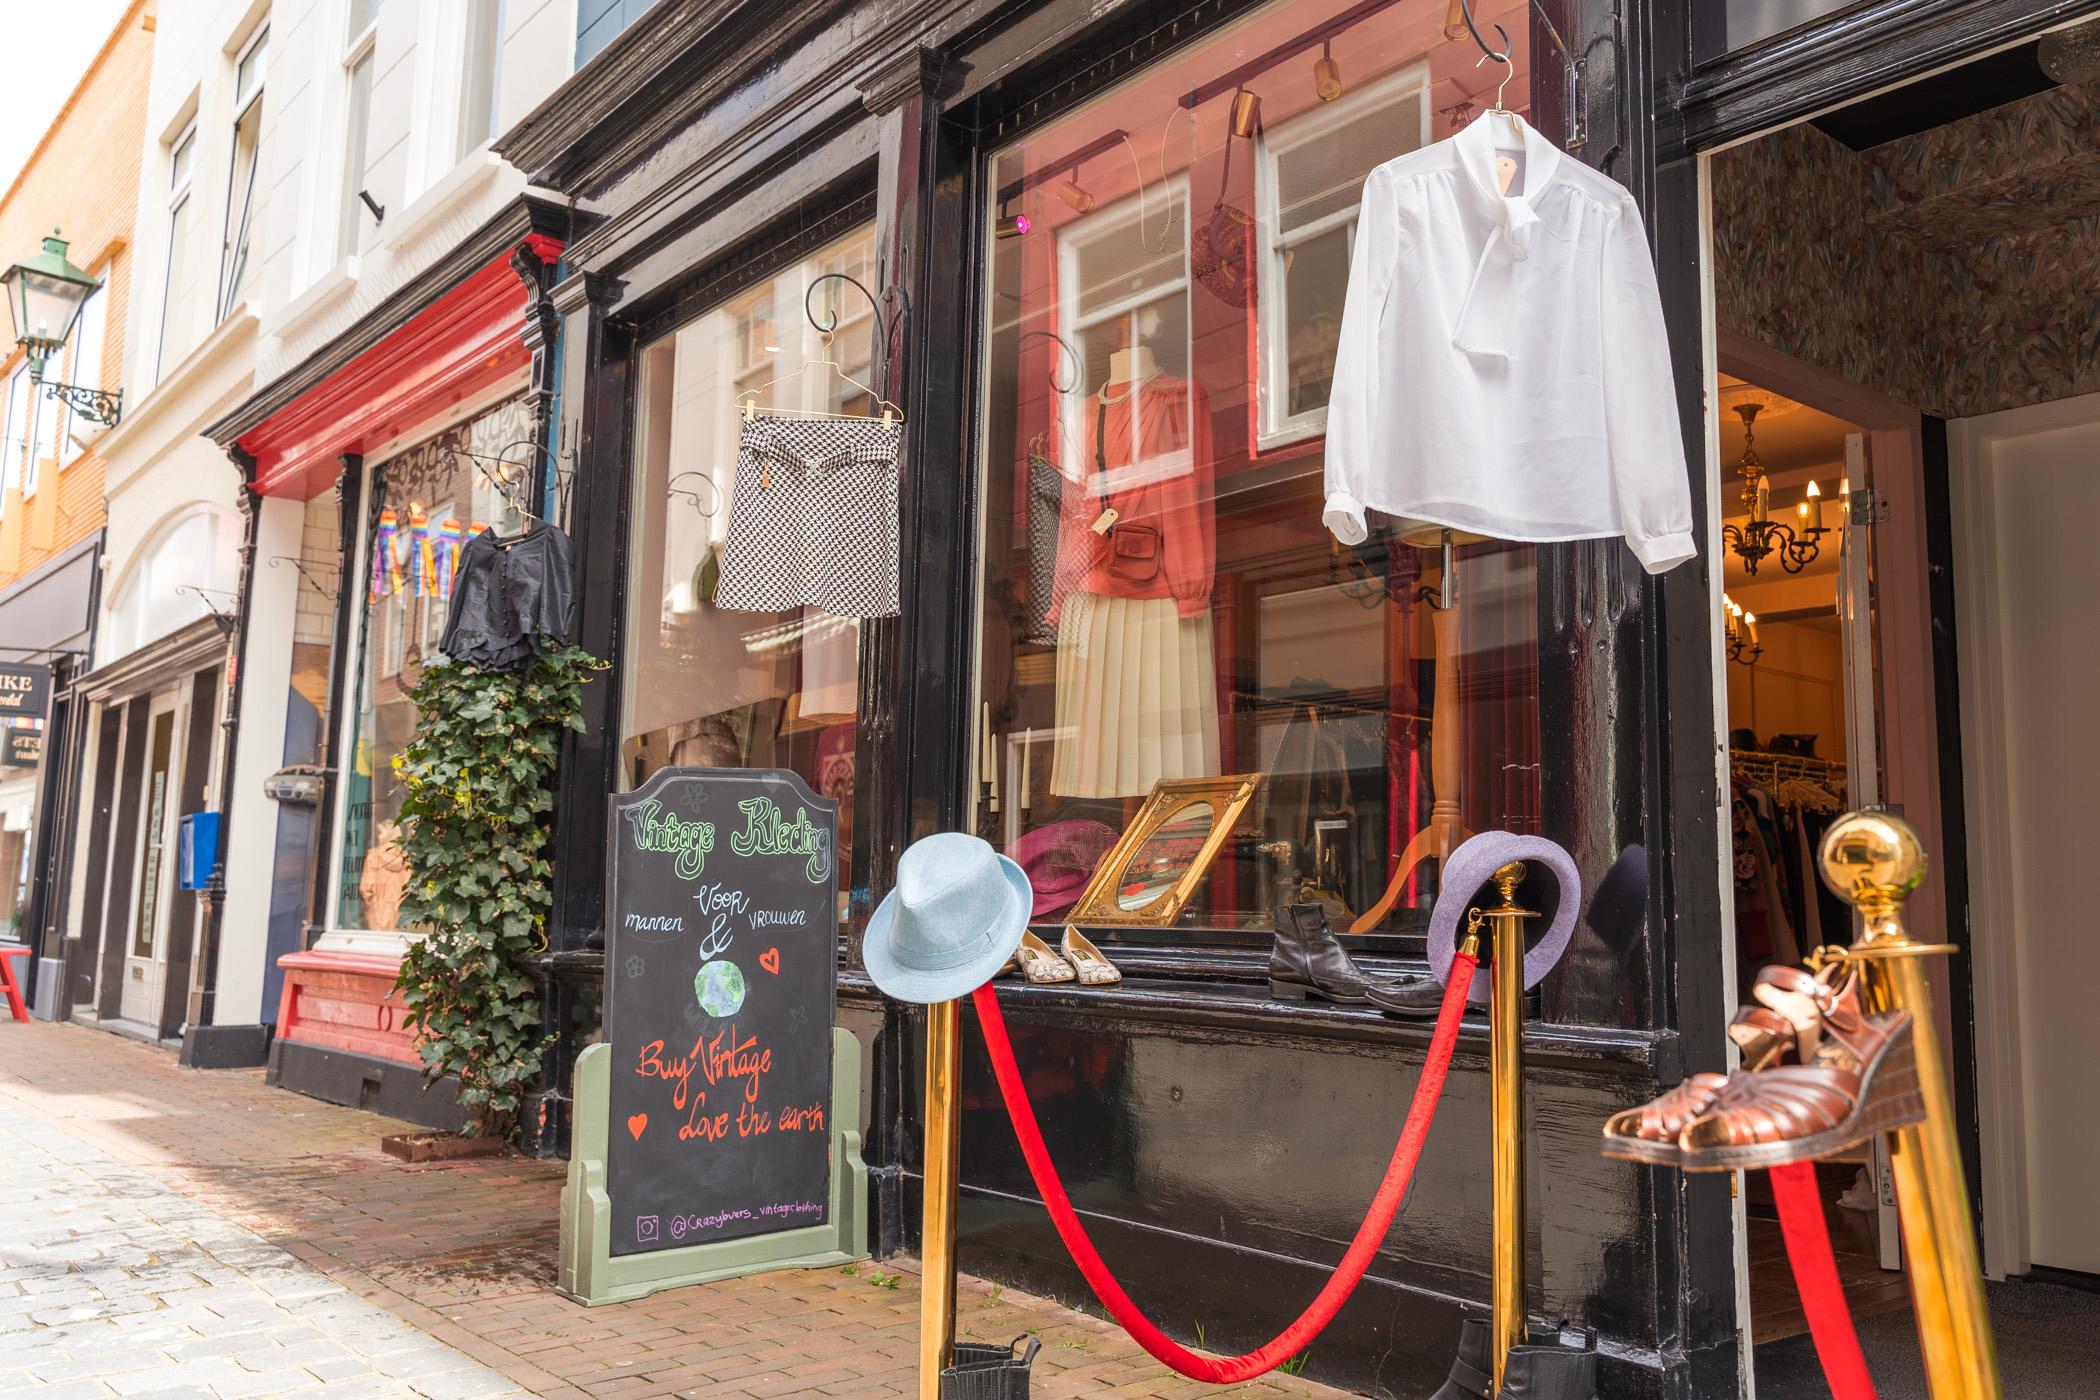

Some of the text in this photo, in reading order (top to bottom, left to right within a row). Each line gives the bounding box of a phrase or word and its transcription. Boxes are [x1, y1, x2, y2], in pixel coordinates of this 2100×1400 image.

[625, 797, 830, 883] Vintage Kleding
[625, 912, 685, 931] mannen
[700, 913, 734, 961] &
[636, 1024, 771, 1110] Buy Vintage
[679, 1092, 824, 1142] Love the earth
